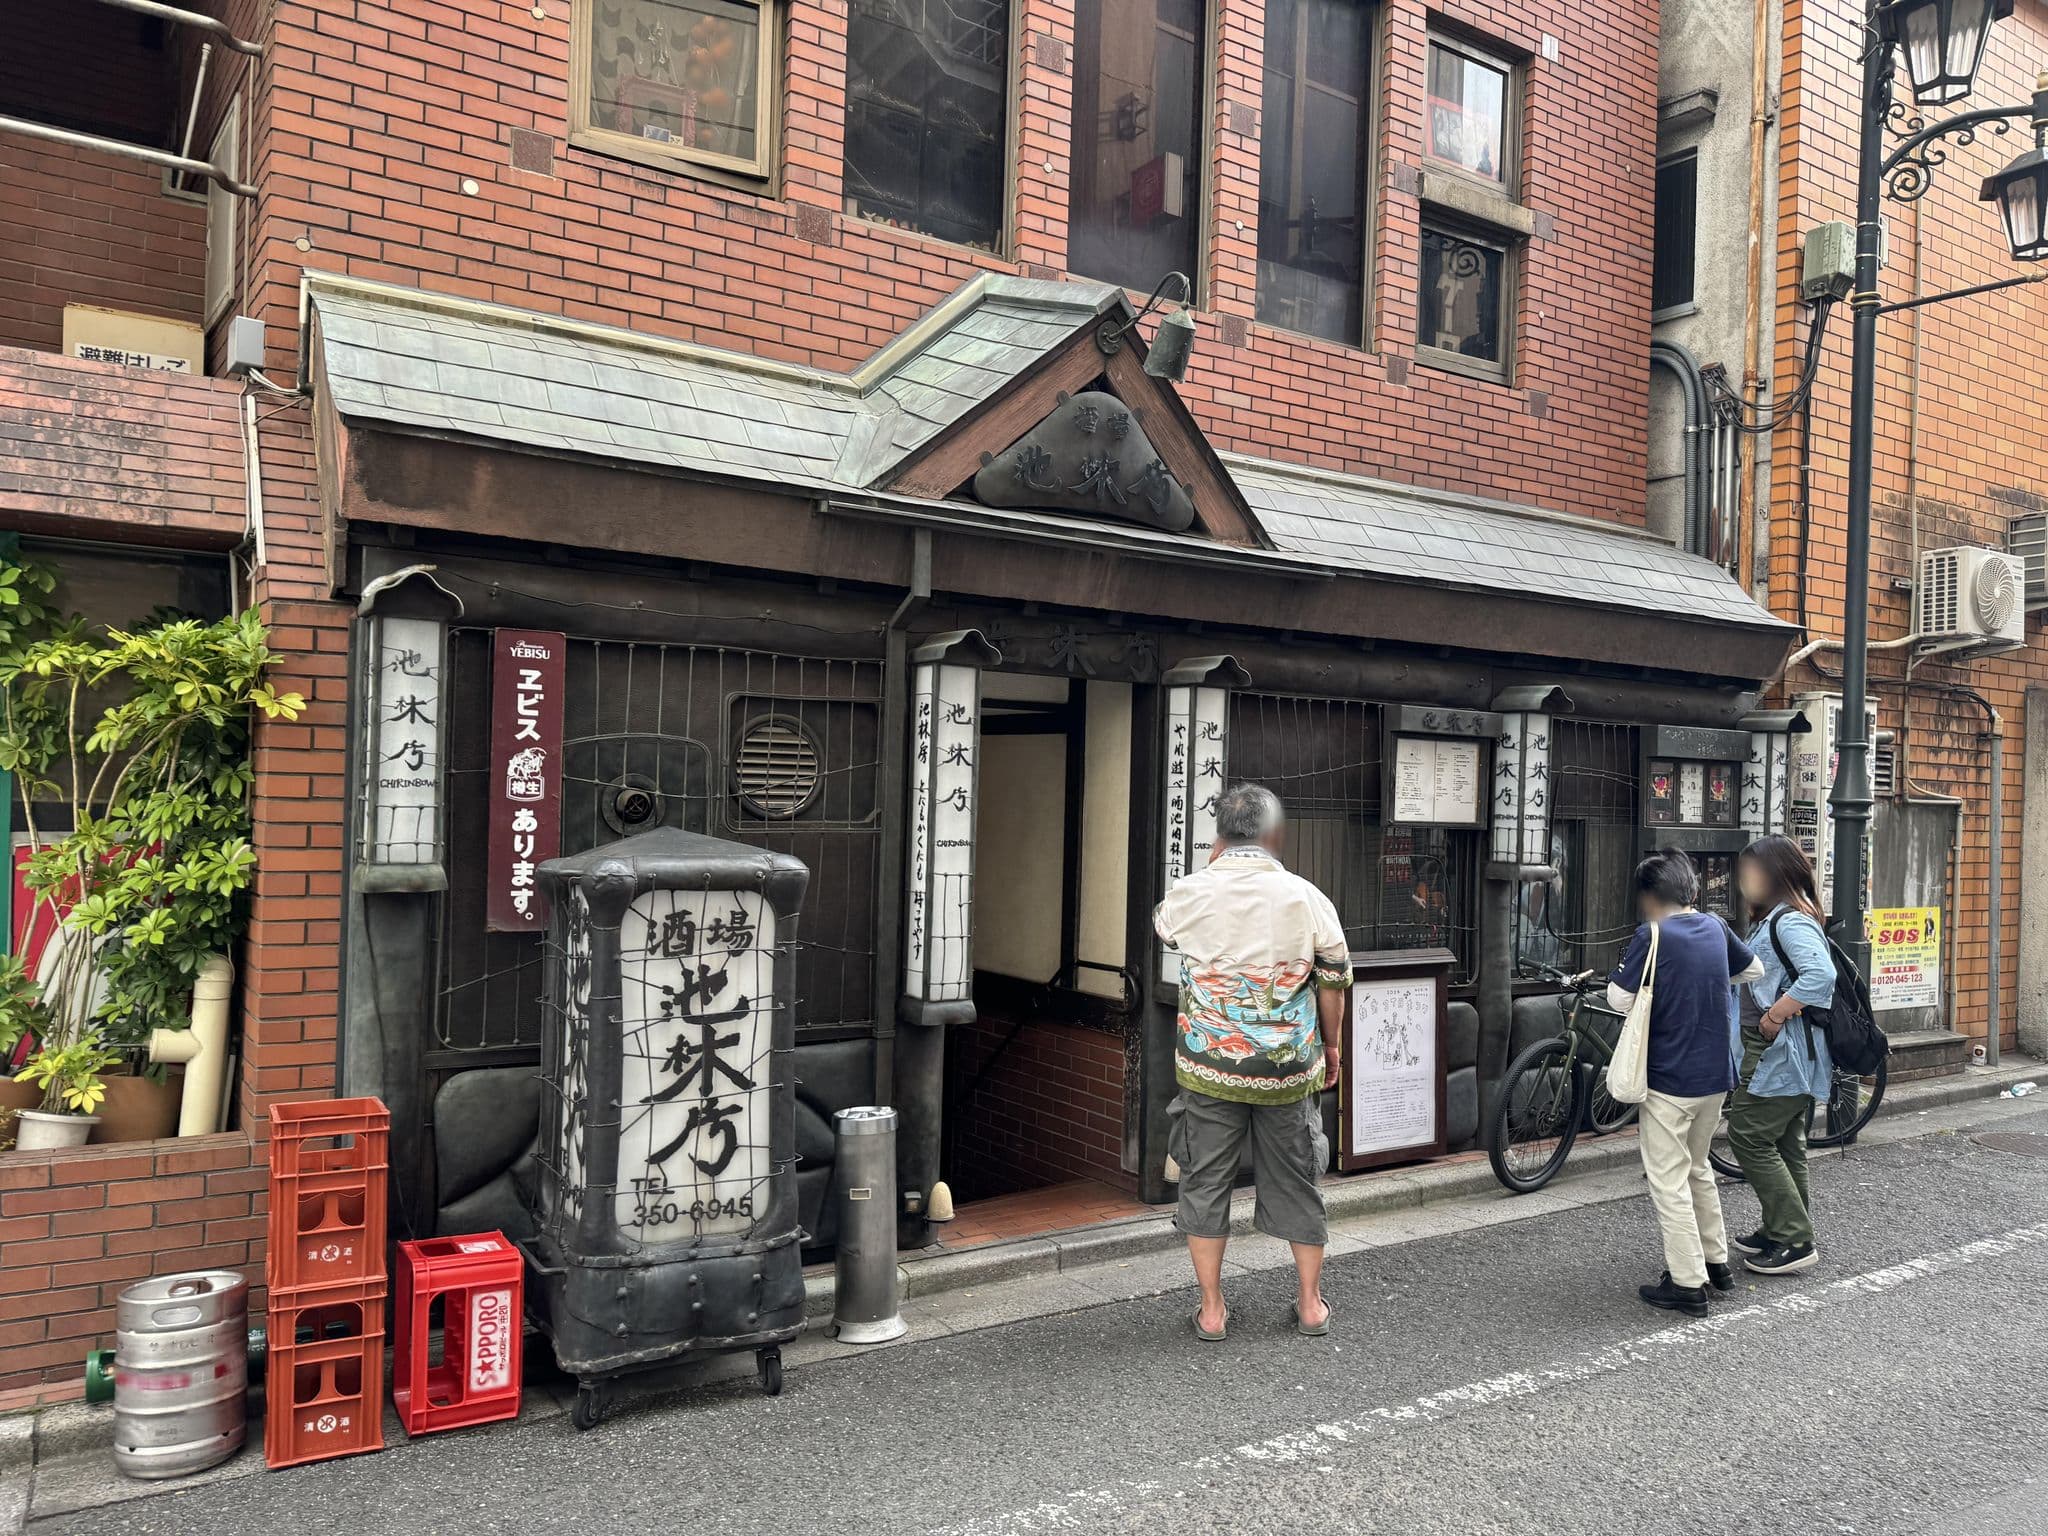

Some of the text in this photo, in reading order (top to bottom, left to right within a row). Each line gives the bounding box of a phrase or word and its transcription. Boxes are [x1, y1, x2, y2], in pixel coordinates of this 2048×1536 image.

[509, 647, 551, 660] YEBISU
[510, 807, 538, 920] あります。
[647, 909, 756, 958] 酒場
[1878, 928, 1920, 945] SOS
[1877, 973, 1923, 985] 0120-045-123
[629, 1177, 675, 1196] TEL
[632, 1196, 754, 1228] 350-6945
